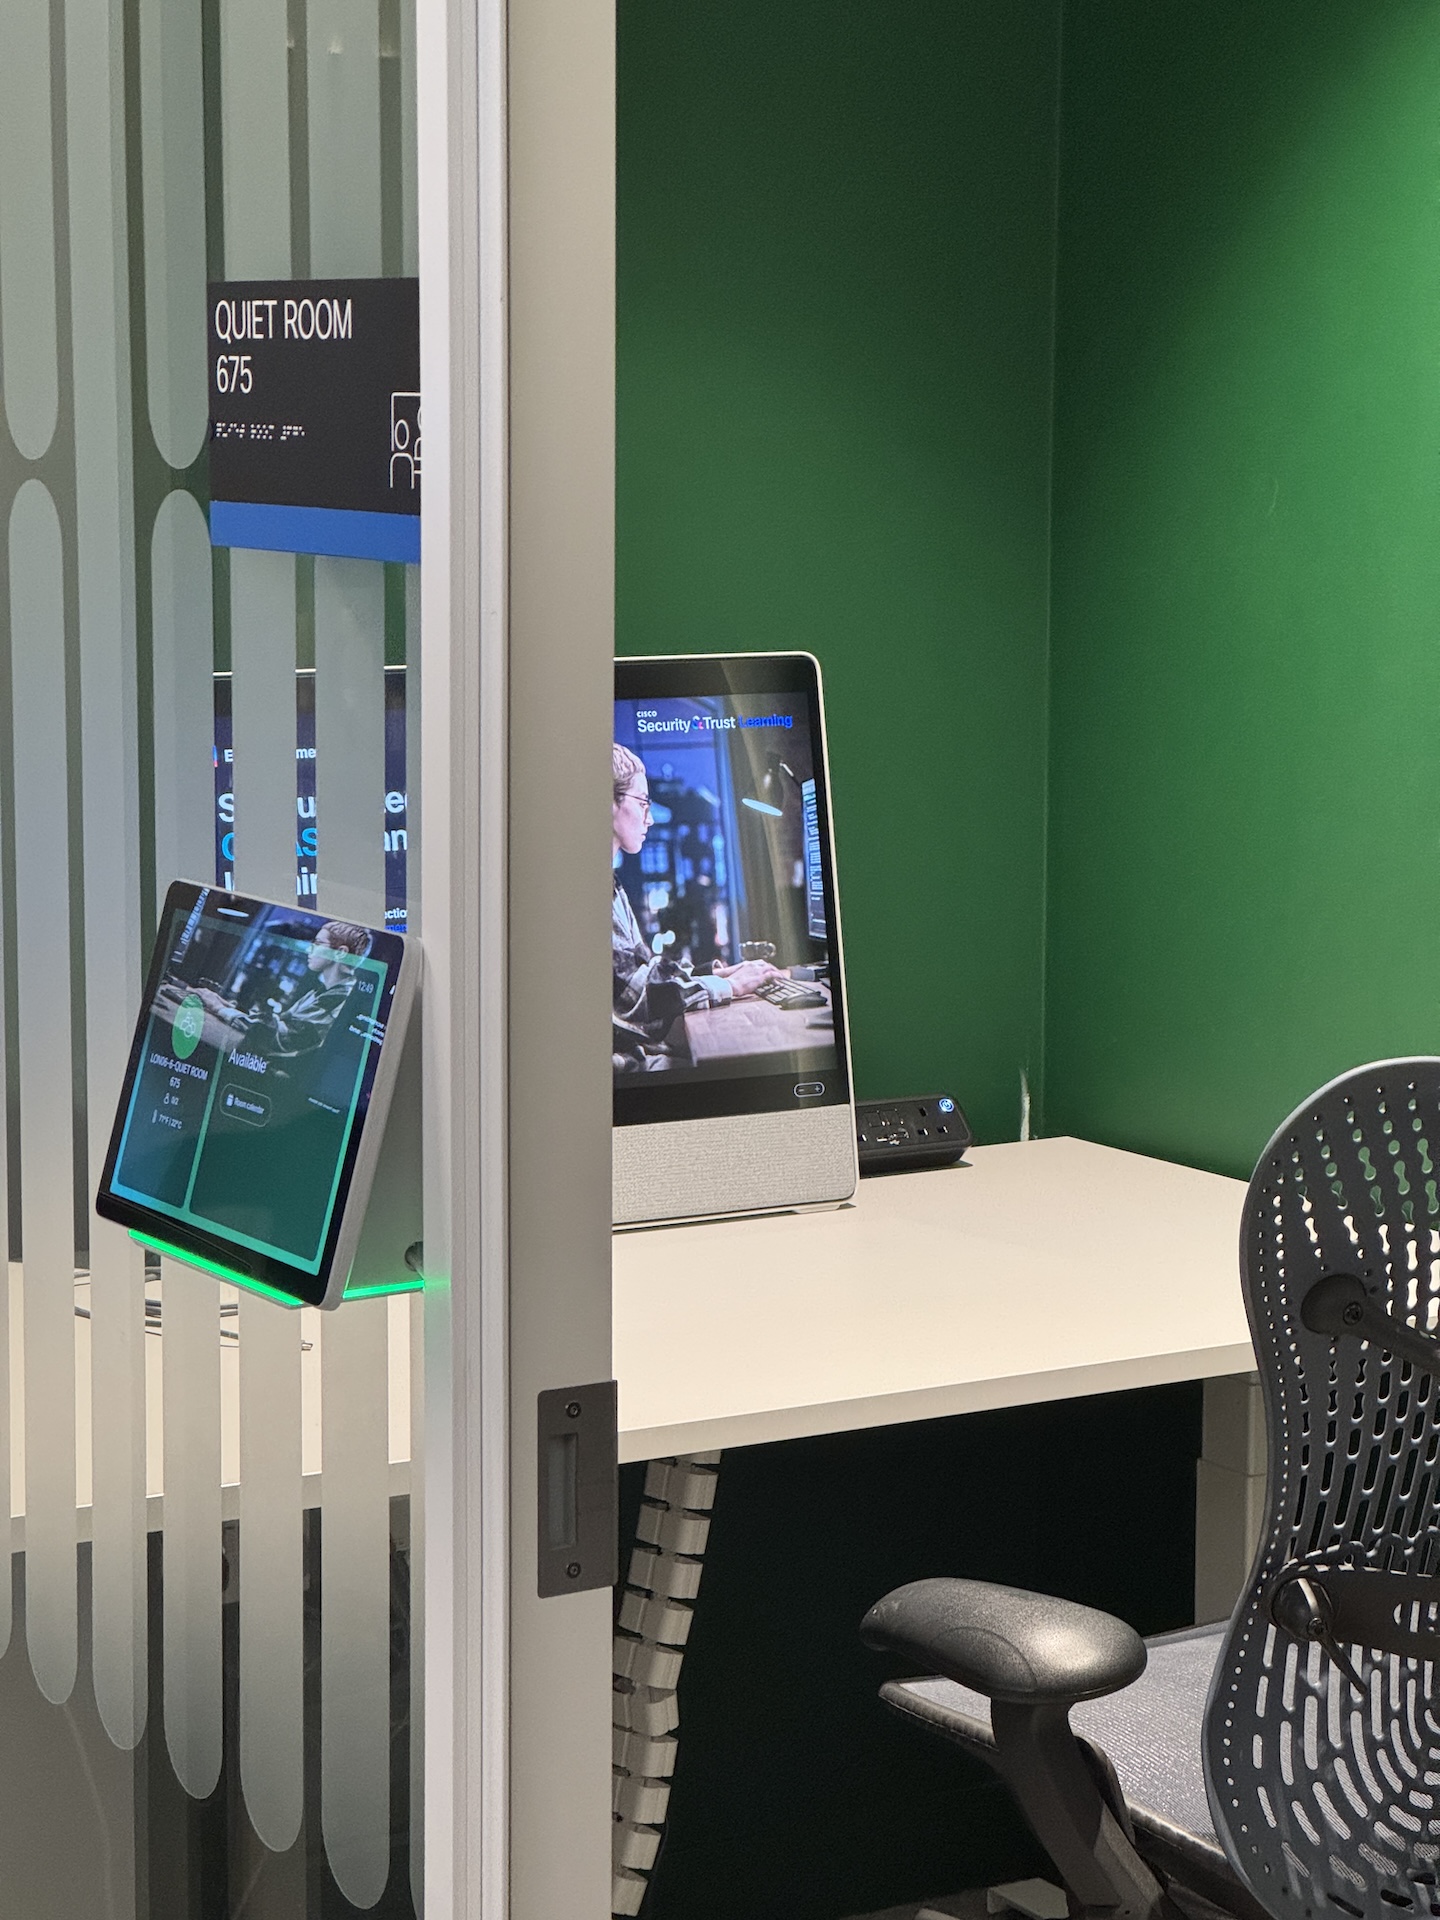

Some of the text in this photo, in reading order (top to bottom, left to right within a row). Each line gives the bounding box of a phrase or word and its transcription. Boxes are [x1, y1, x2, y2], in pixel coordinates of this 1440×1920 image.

[215, 298, 353, 344] QUIET ROOM
[216, 355, 254, 394] 675
[637, 718, 691, 734] Security
[703, 716, 736, 730] Trust
[738, 713, 793, 729] Learning
[228, 1048, 267, 1074] Available
[169, 1076, 181, 1089] 675
[190, 1066, 209, 1081] ROOM
